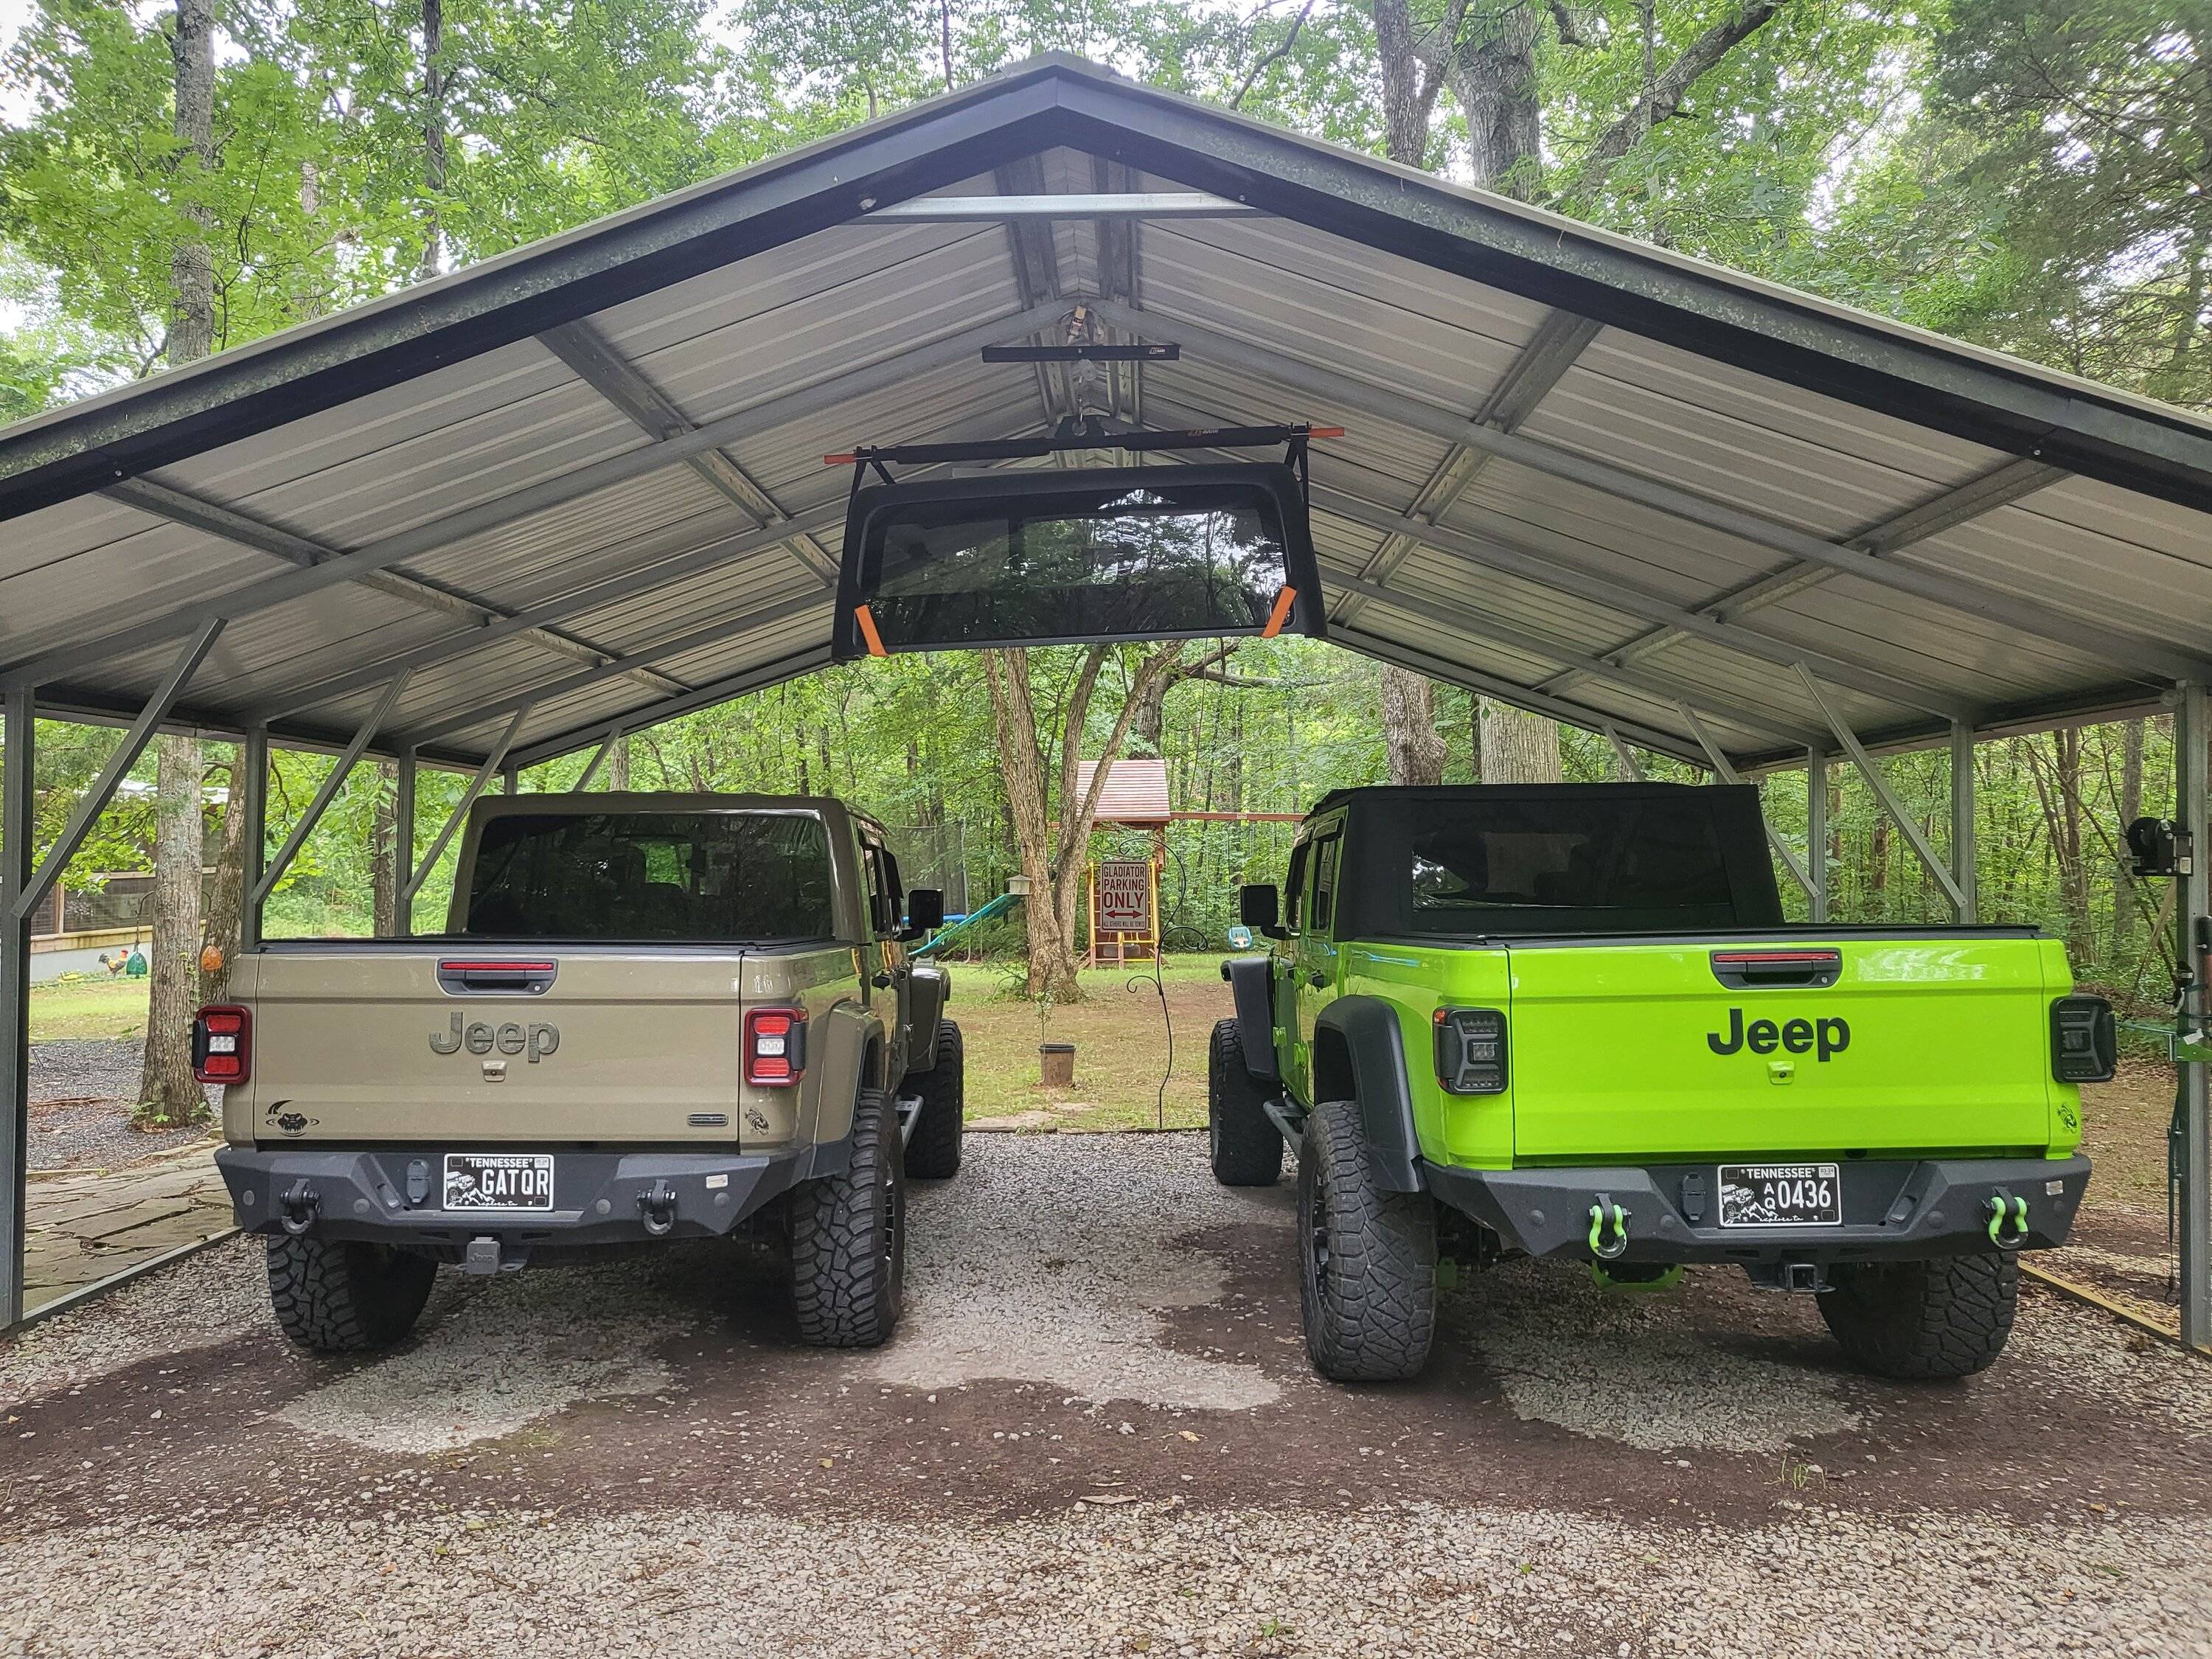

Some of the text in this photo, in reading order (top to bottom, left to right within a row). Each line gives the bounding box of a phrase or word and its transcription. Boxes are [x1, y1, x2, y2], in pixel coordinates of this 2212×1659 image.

[1104, 866, 1144, 877] GLADIATOR
[1104, 879, 1144, 891] PARKING
[1104, 892, 1144, 908] ONLY
[429, 1012, 560, 1062] Jeep
[1707, 1008, 1851, 1062] Jeep
[470, 1158, 529, 1168] TENNESSEE
[1747, 1168, 1812, 1179] TENNESSEE
[1778, 1180, 1832, 1208] 0436
